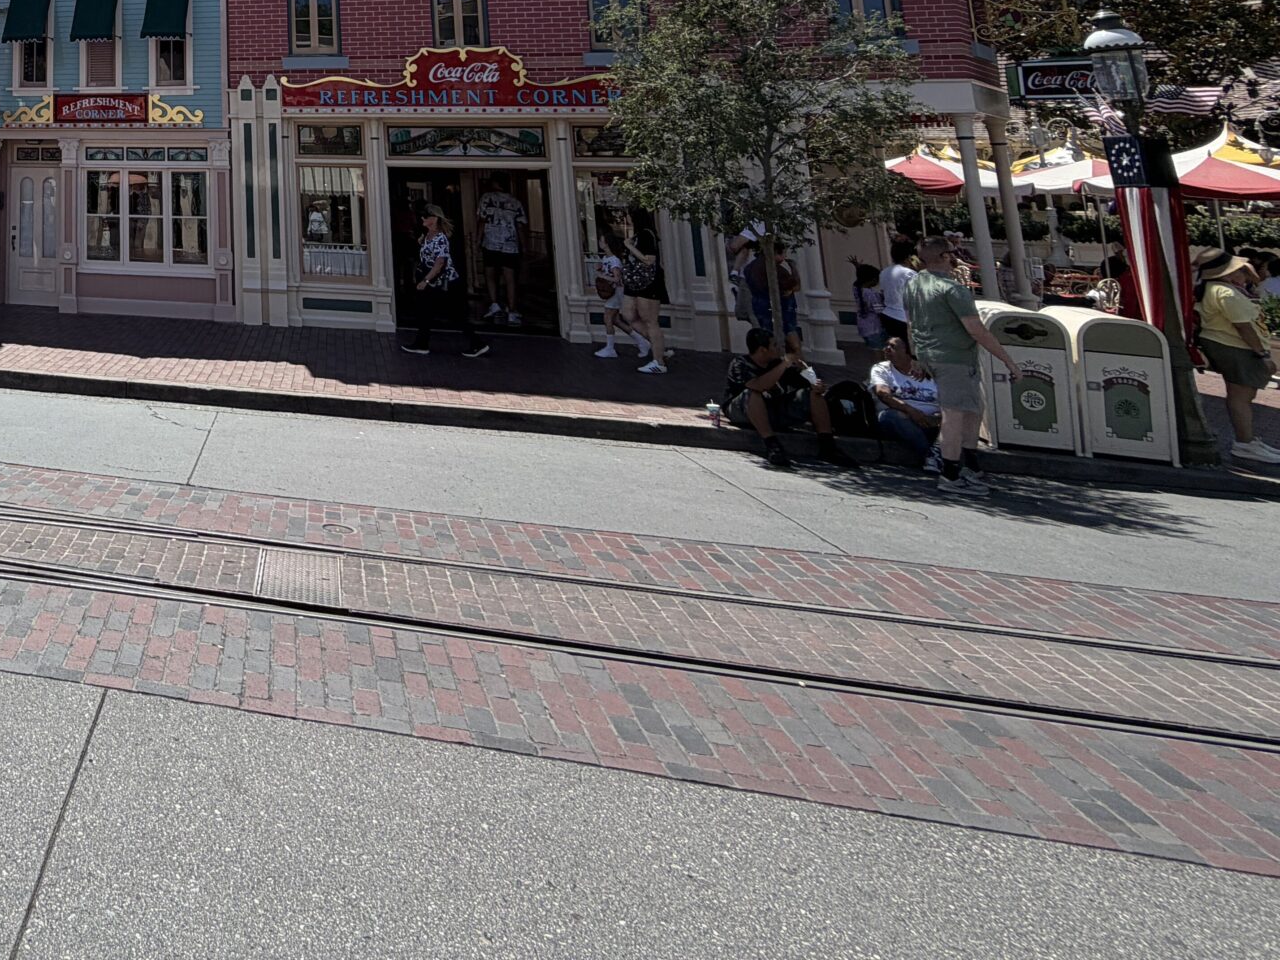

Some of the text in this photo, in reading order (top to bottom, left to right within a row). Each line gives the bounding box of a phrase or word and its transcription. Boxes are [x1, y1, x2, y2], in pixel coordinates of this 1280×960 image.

[429, 62, 500, 83] Coca-Cola
[1028, 70, 1101, 89] Coca-Col
[62, 97, 141, 116] REFRESHMENT
[320, 90, 498, 105] REFRESHMENT
[75, 109, 126, 119] CORNER
